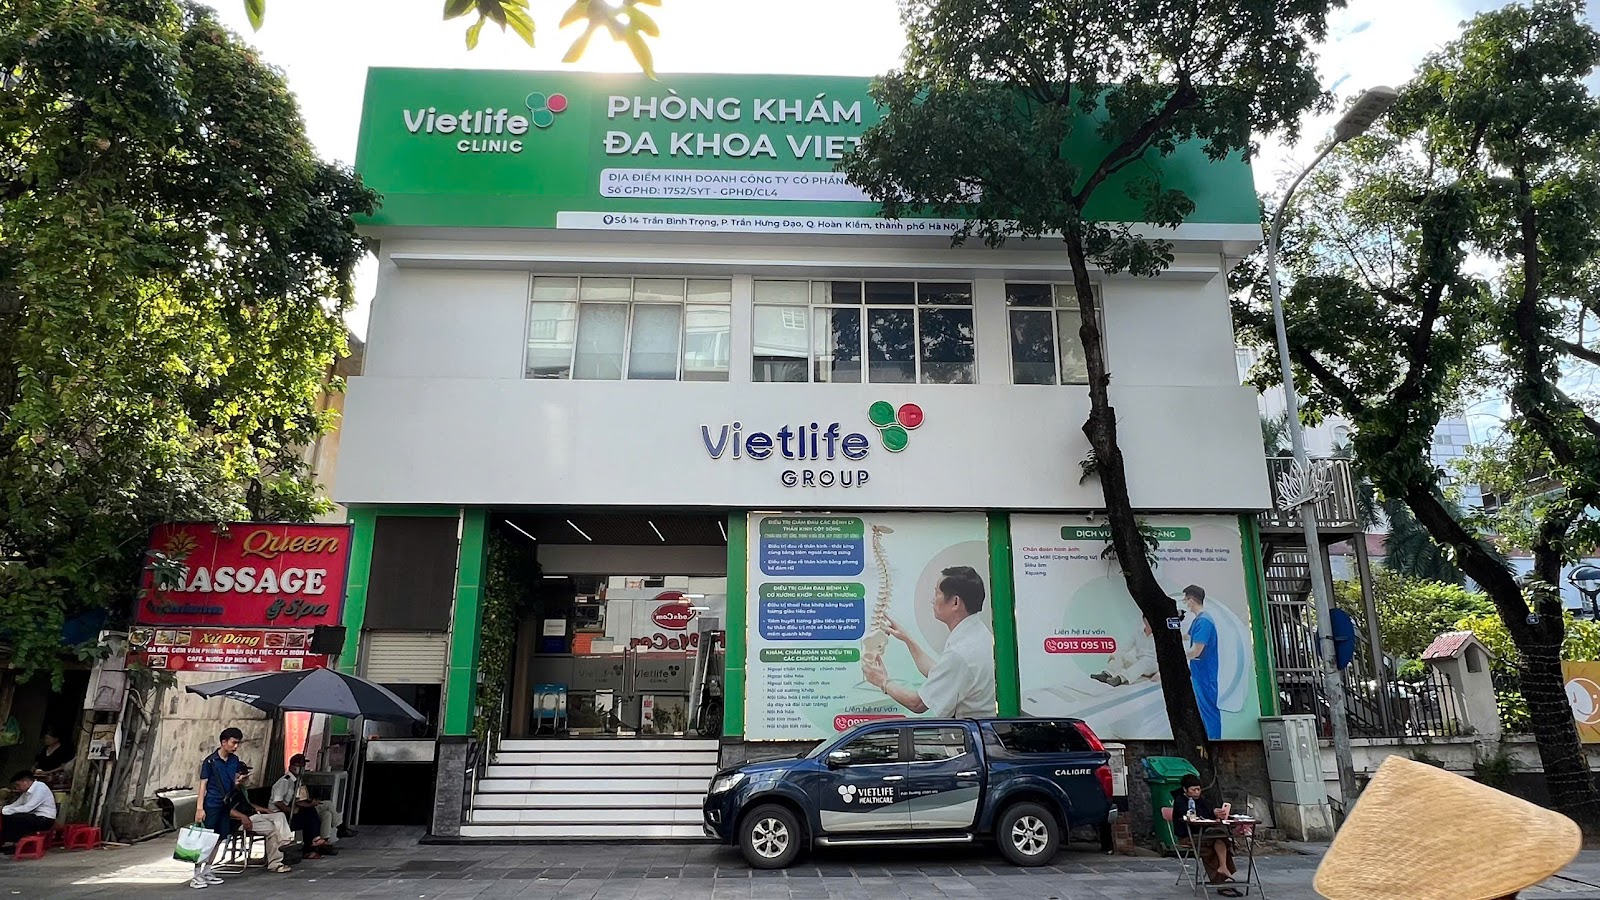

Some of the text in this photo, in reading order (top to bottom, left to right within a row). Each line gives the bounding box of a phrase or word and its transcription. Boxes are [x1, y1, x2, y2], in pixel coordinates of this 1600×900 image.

[608, 88, 861, 124] PHÒNG KHÁM
[403, 107, 529, 135] Vietlife
[457, 139, 523, 152] CLINIC
[603, 131, 659, 155] ĐA
[669, 132, 777, 157] KHOA
[608, 173, 629, 182] ĐỊA
[664, 174, 692, 182] KINH
[695, 175, 737, 183] DOANH
[740, 174, 772, 184] CÔNG
[608, 185, 621, 194] Số
[624, 187, 660, 195] GPHĐ:
[664, 187, 711, 196] 1752/SYT
[720, 188, 778, 196] GPHĐ/CL4
[614, 216, 627, 224] Số
[642, 217, 664, 225] Trần
[667, 217, 687, 225] Bình
[689, 218, 719, 227] Trọng,
[732, 219, 752, 227] Trần
[754, 219, 780, 228] Hưng
[783, 220, 804, 229] Đạo,
[818, 221, 842, 229] Hoàn
[874, 222, 903, 230] thành
[906, 222, 925, 232] phố
[929, 223, 942, 231] Hà
[944, 222, 959, 231] Nội
[700, 421, 870, 460] Vietlife
[781, 469, 870, 488] GROUP
[1076, 530, 1097, 538] DỊCH
[241, 529, 339, 559] Queen
[283, 599, 329, 619] Spa
[222, 633, 261, 646] Đông
[858, 787, 894, 796] VIETLIFE
